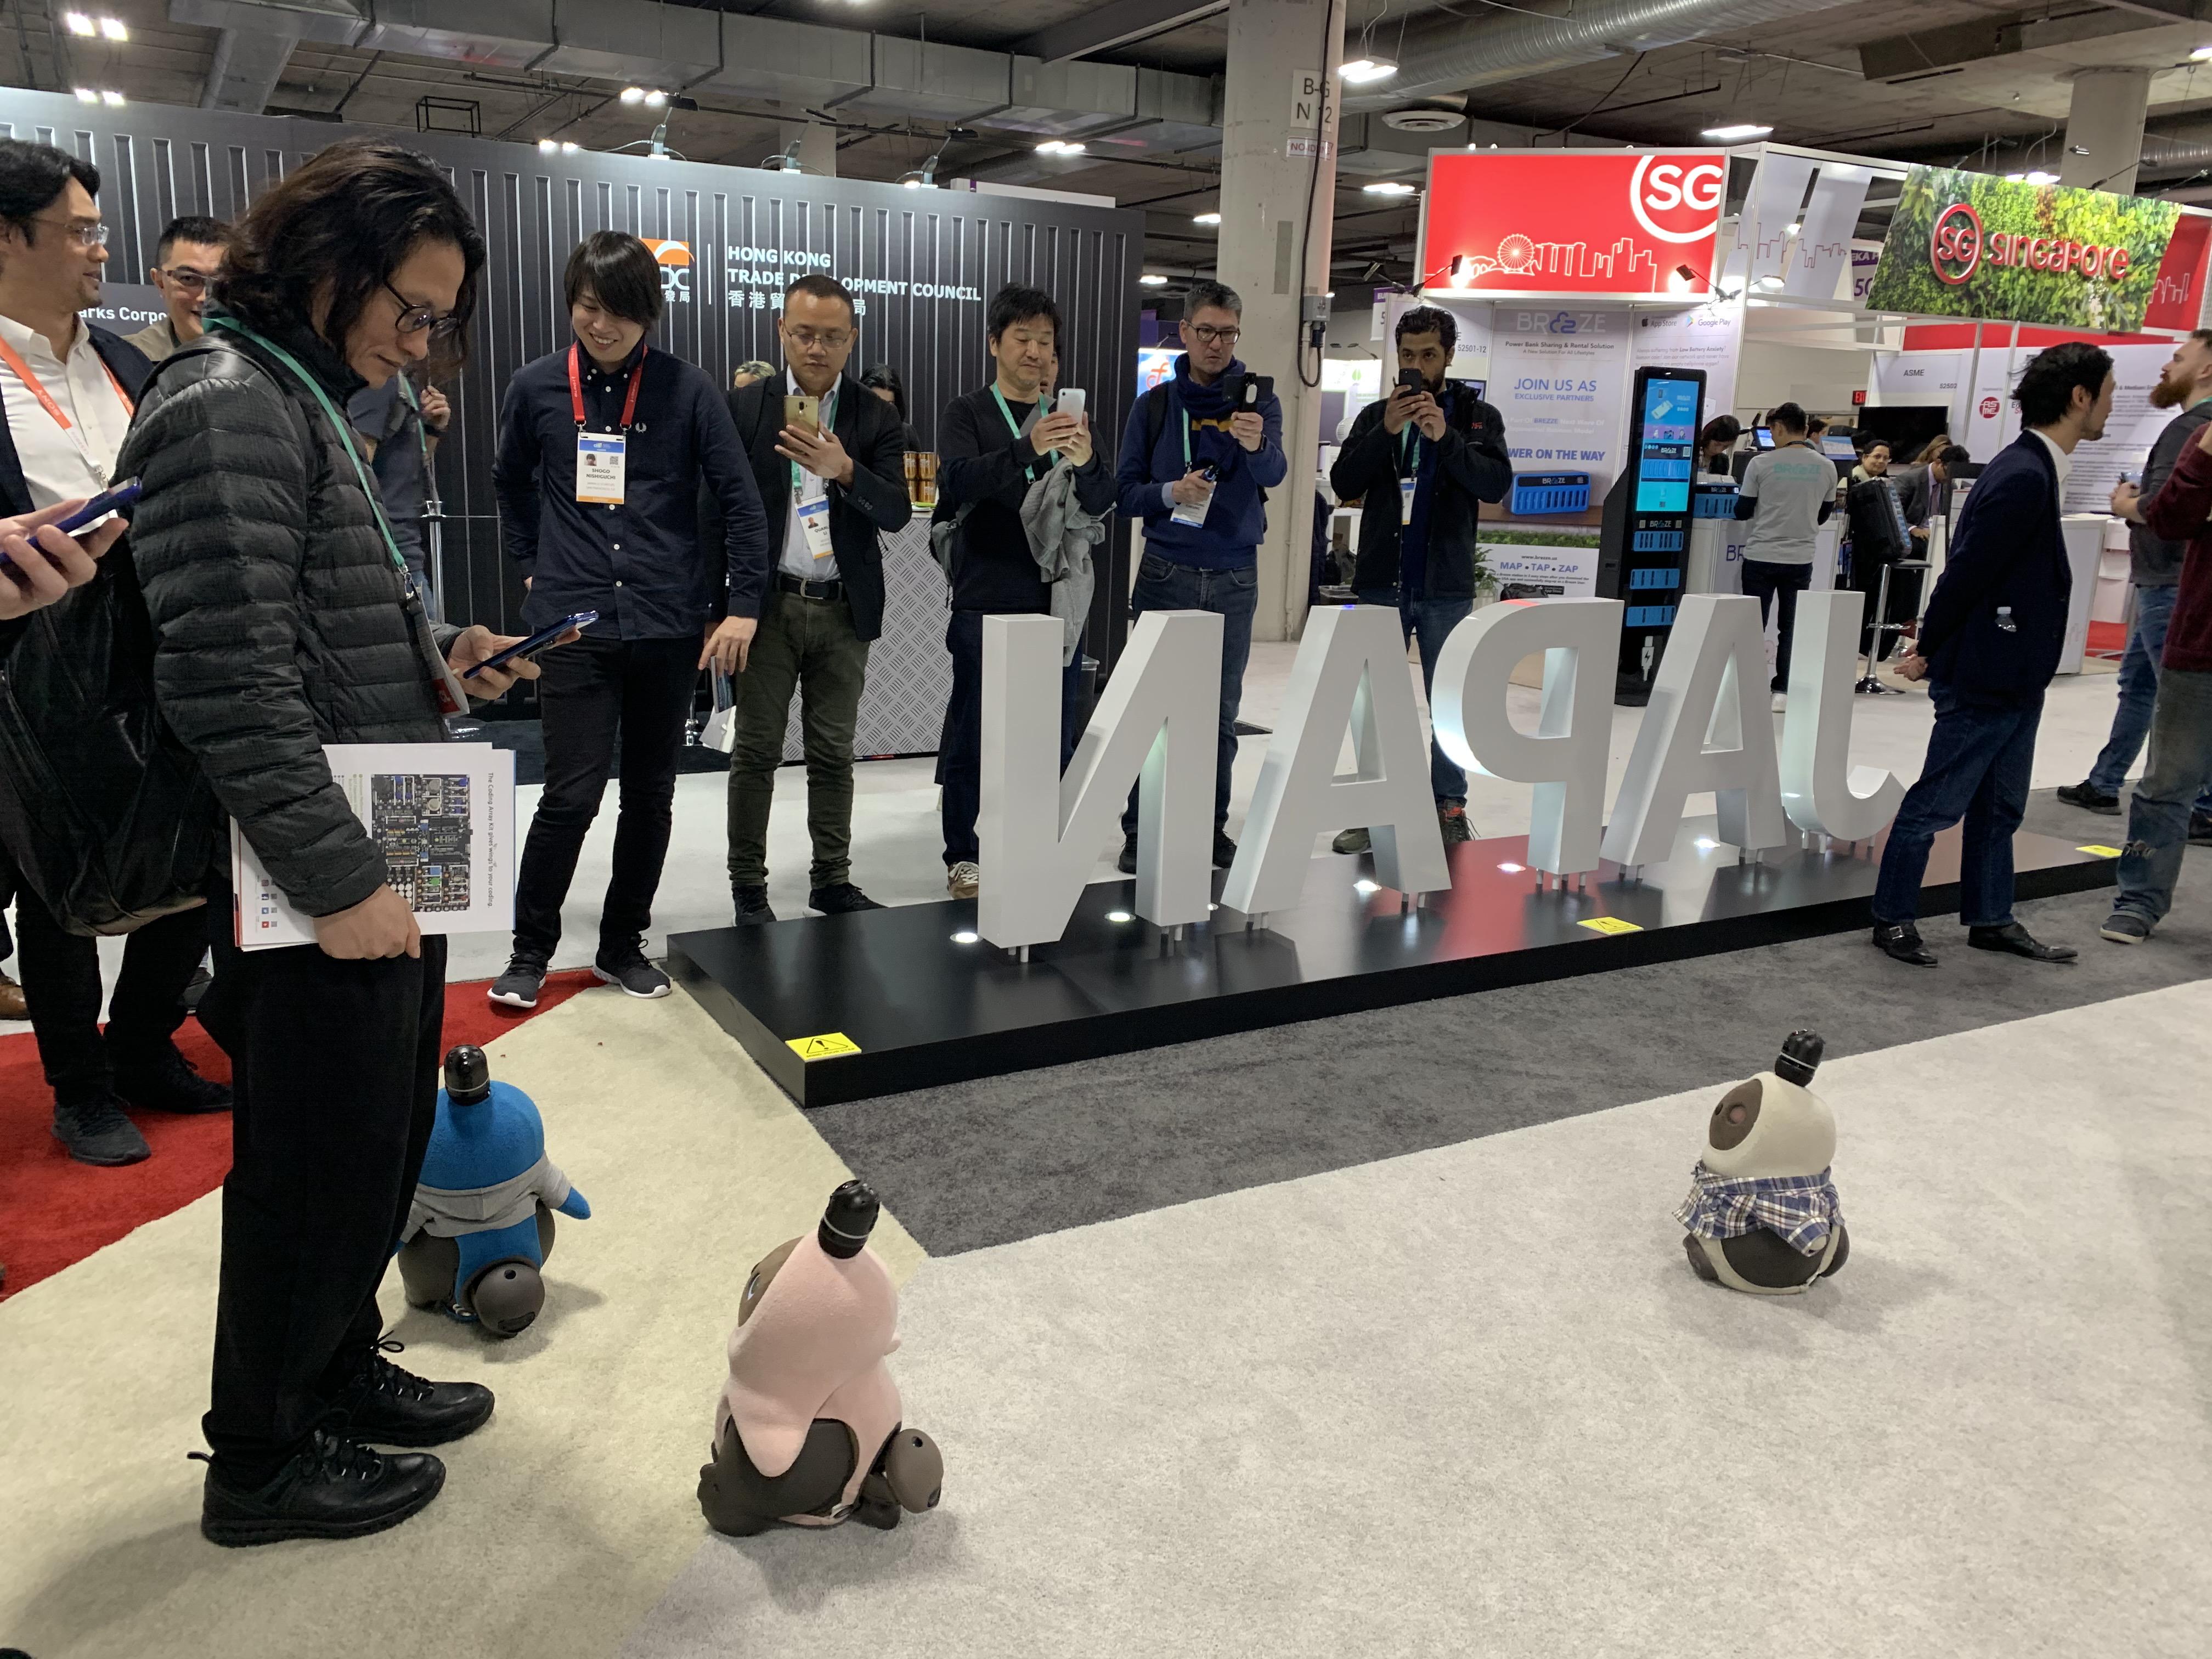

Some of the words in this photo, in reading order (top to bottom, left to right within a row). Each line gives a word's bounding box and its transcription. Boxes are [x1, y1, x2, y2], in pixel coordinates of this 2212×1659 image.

[1297, 103, 1311, 120] N
[1291, 143, 1305, 151] NO
[1646, 165, 1723, 210] SG
[1937, 227, 1976, 262] SG
[729, 246, 778, 263] HONG
[783, 251, 831, 268] KONG
[728, 269, 785, 285] TRADE
[912, 283, 981, 301] COUNCIL
[1698, 319, 1718, 328] Google
[1719, 318, 1731, 326] Play
[1458, 345, 1487, 353] 52501-12
[1514, 378, 1549, 390] JOIN
[1555, 379, 1573, 391] US
[1577, 380, 1597, 392] AS
[1536, 449, 1553, 459] ON
[1556, 449, 1578, 460] THE
[1580, 450, 1606, 461] WAY
[1500, 561, 1522, 570] MAP
[1558, 565, 1579, 573] ZAP
